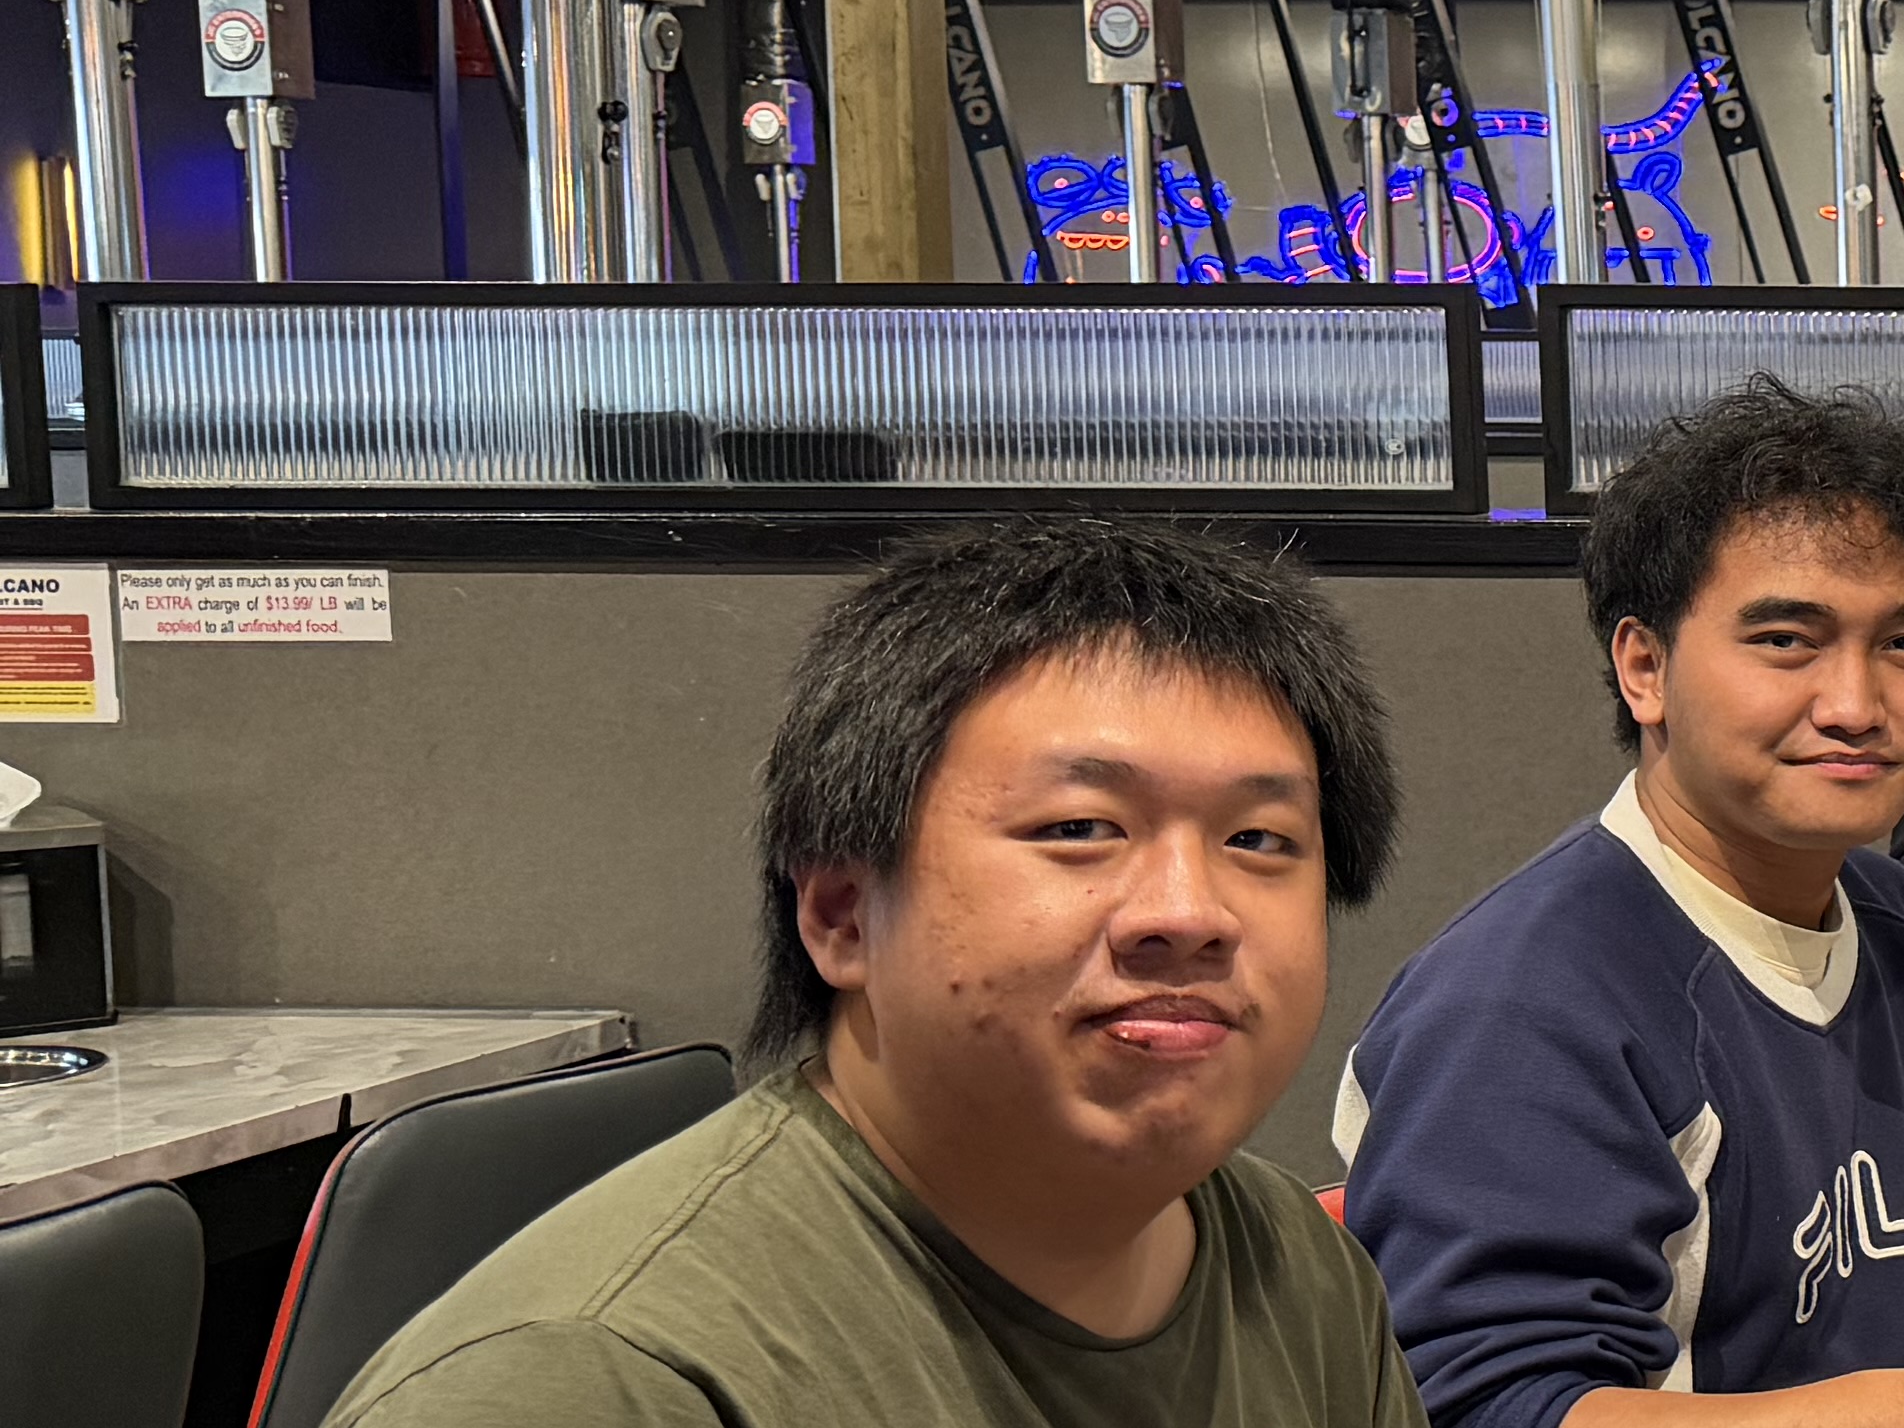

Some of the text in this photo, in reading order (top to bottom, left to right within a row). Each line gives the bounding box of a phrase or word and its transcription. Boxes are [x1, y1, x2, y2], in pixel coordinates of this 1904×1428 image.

[121, 574, 383, 592] Please only get as much as you can finish.
[122, 596, 387, 614] An EXTRA charge of $13.99/ LB will be
[157, 619, 343, 635] applied to all unfinished food.
